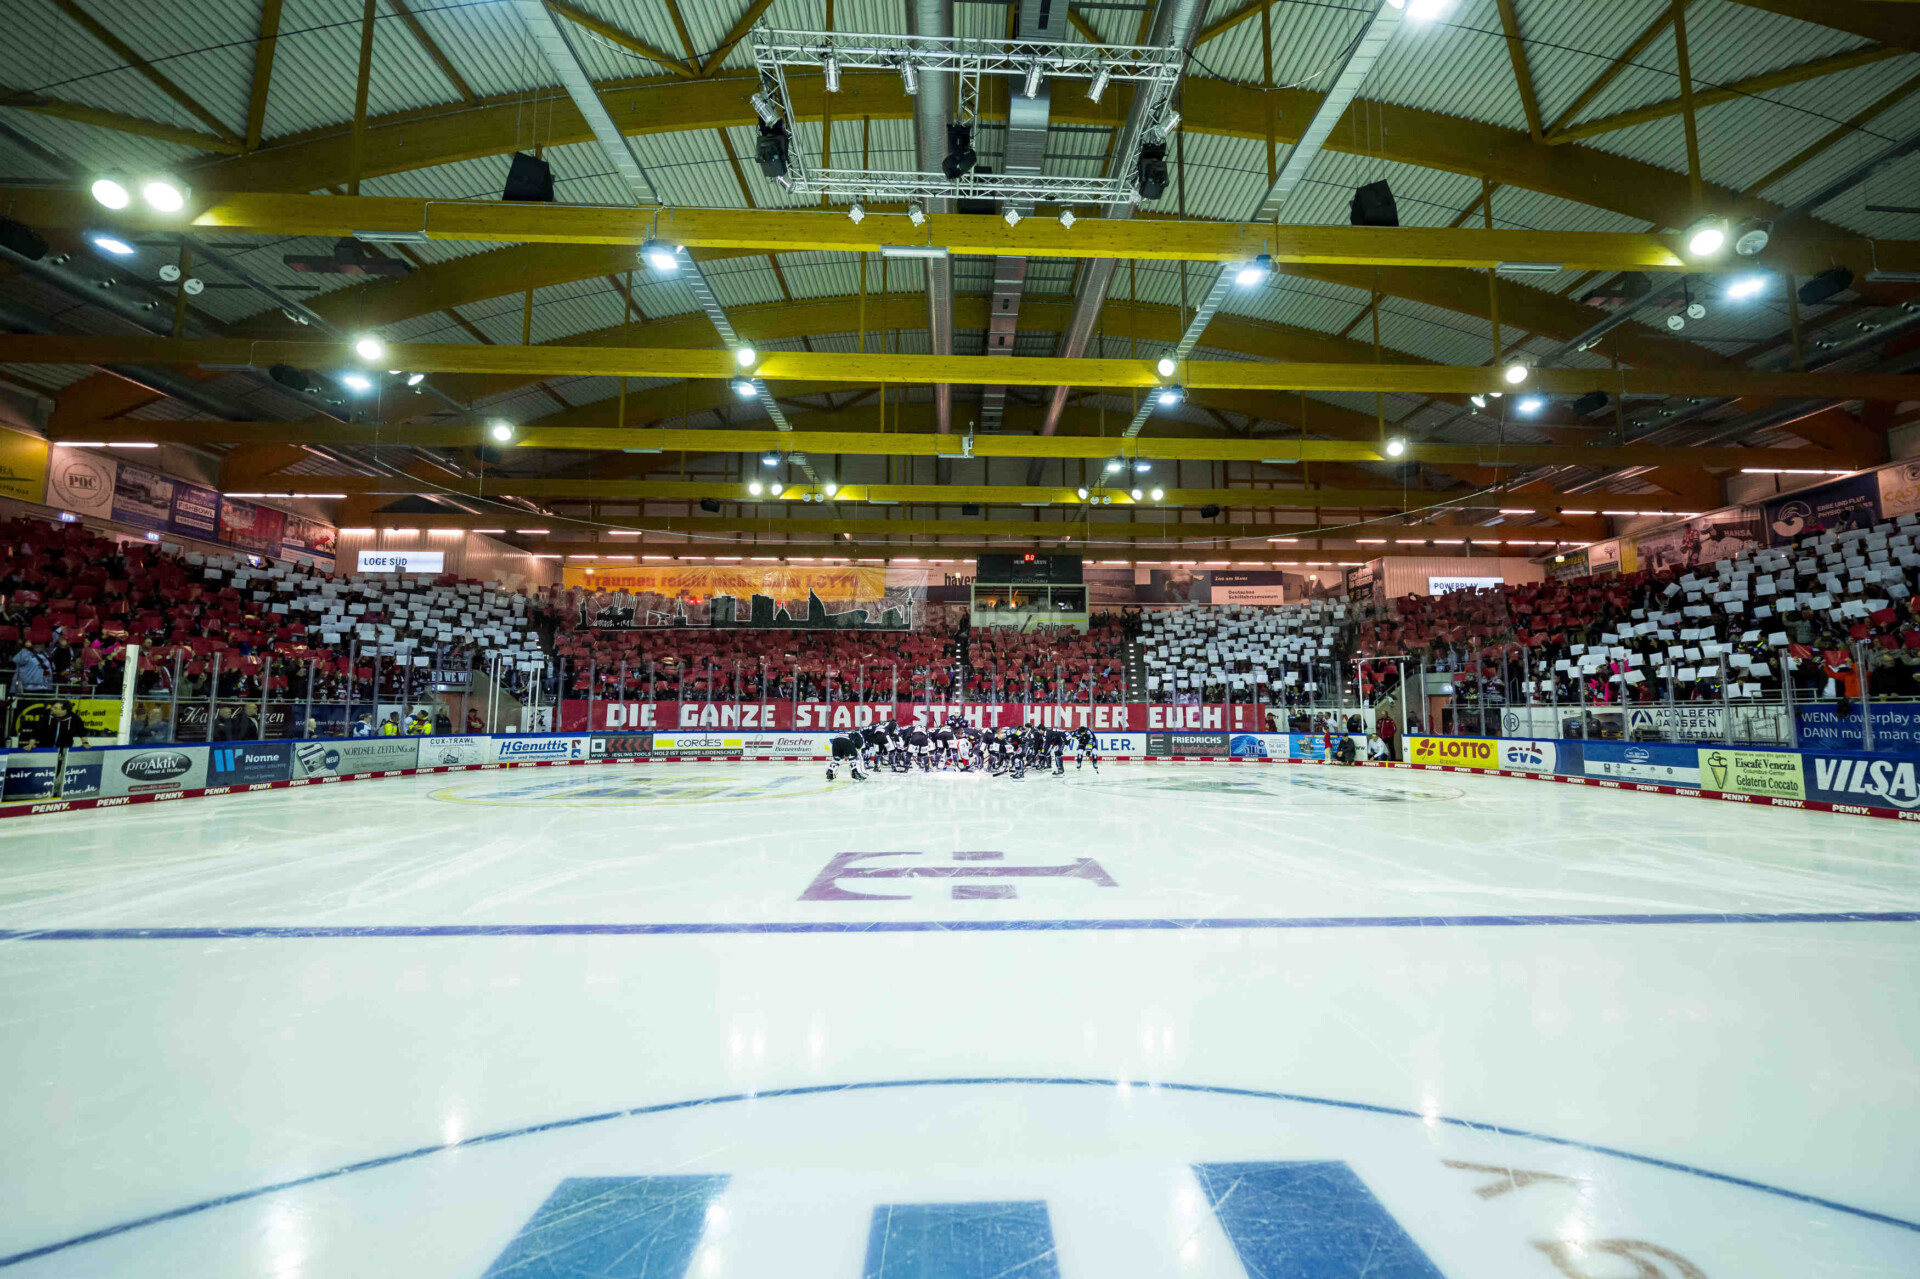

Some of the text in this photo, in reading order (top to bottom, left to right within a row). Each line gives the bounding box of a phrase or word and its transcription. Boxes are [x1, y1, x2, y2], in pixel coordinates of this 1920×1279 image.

[178, 501, 213, 517] FISHBOWL
[364, 556, 408, 566] LOGE SÜD
[989, 622, 1018, 632] Frese
[606, 704, 656, 726] DIE
[680, 704, 776, 727] GANZE
[796, 704, 892, 727] STADT
[1024, 705, 1130, 728] HINTER
[1150, 706, 1222, 728] EUCH
[1802, 712, 1838, 722] WENN
[1842, 712, 1910, 726] owerplay
[1172, 736, 1222, 744] FRIEDRICHS
[1804, 728, 1838, 738] DANN
[1880, 730, 1909, 740] man
[343, 747, 375, 756] NORDSEE
[1439, 741, 1490, 759] LOTTO
[245, 754, 280, 763] Nonne
[1736, 758, 1796, 771] Eiscafé Venezia
[126, 756, 180, 775] proAktiv
[1736, 774, 1798, 791] Gelateria Coccato
[1815, 758, 1918, 798] VILSA
